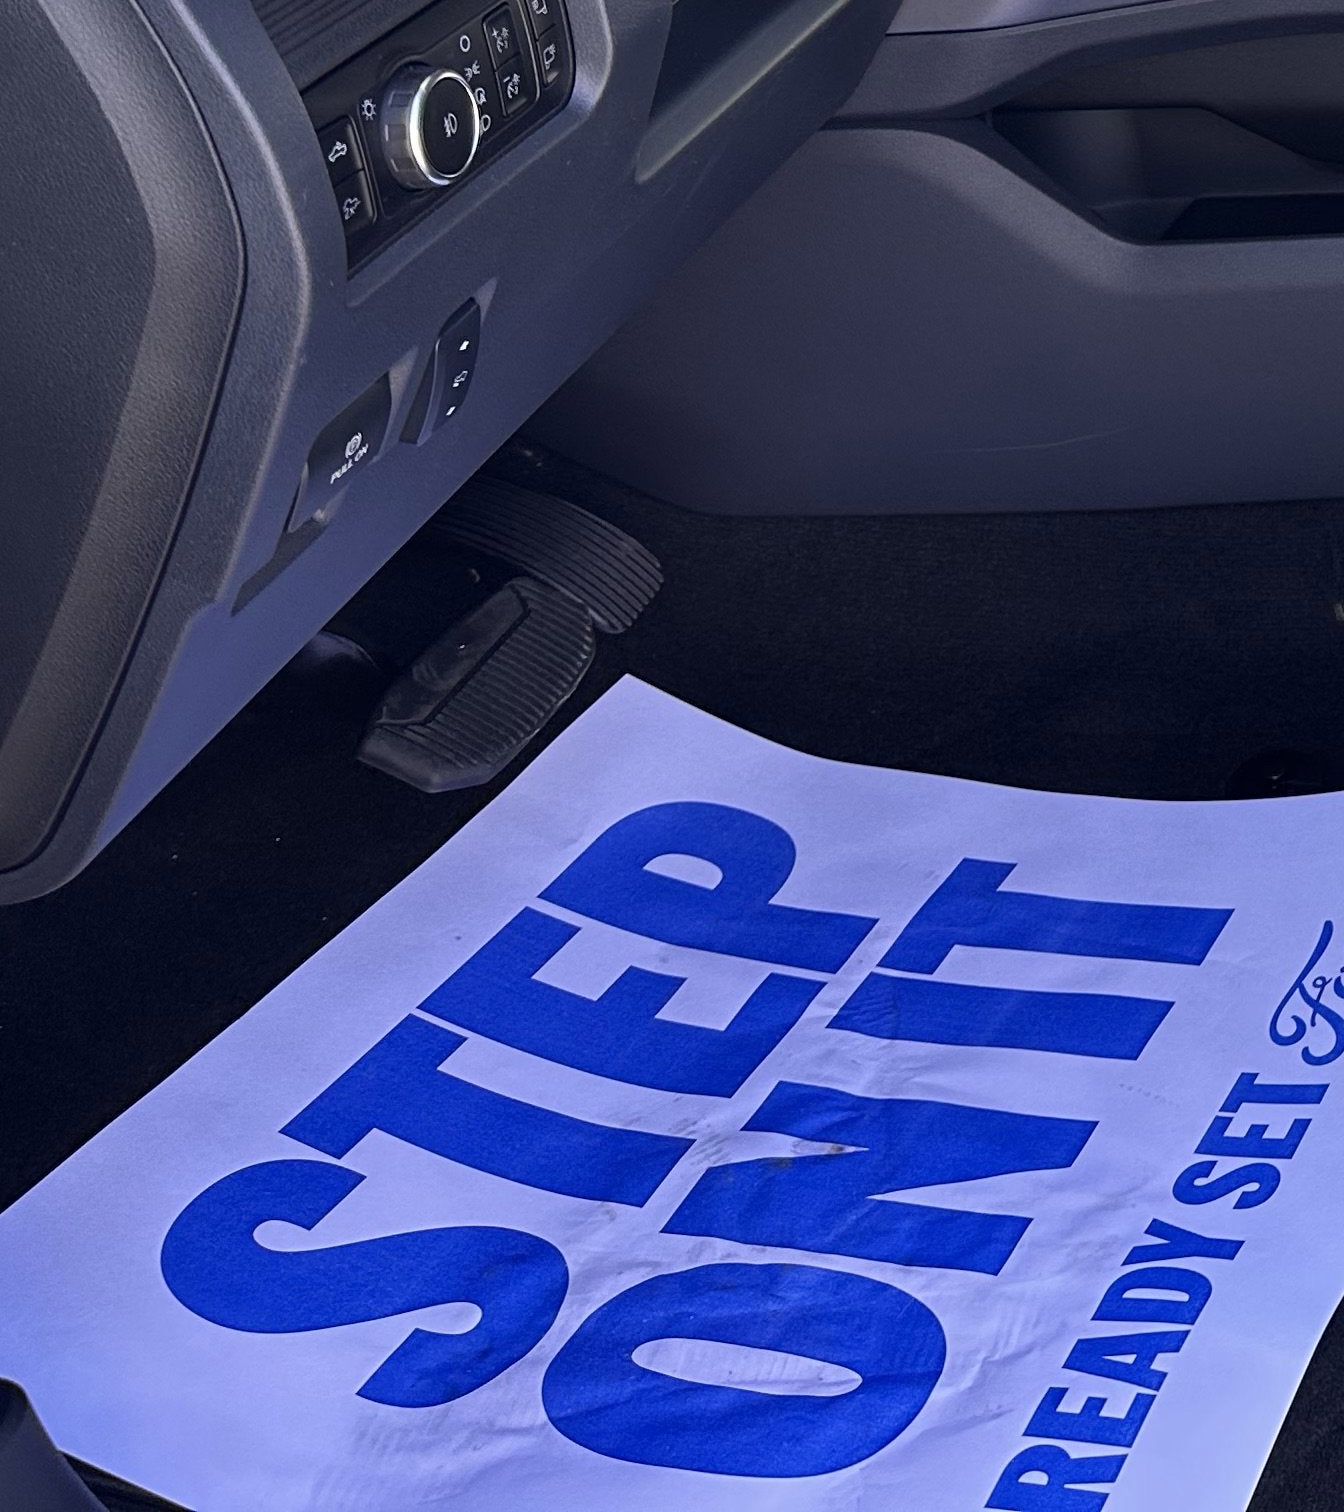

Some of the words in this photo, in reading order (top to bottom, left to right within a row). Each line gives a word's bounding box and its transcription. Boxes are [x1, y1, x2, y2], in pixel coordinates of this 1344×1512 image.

[329, 458, 354, 485] PULL
[354, 442, 369, 462] ON
[161, 800, 880, 1408] STEP
[541, 1082, 1099, 1478] ON
[825, 856, 1235, 1062] IT
[983, 1217, 1246, 1512] READY
[1171, 1071, 1331, 1210] SET
